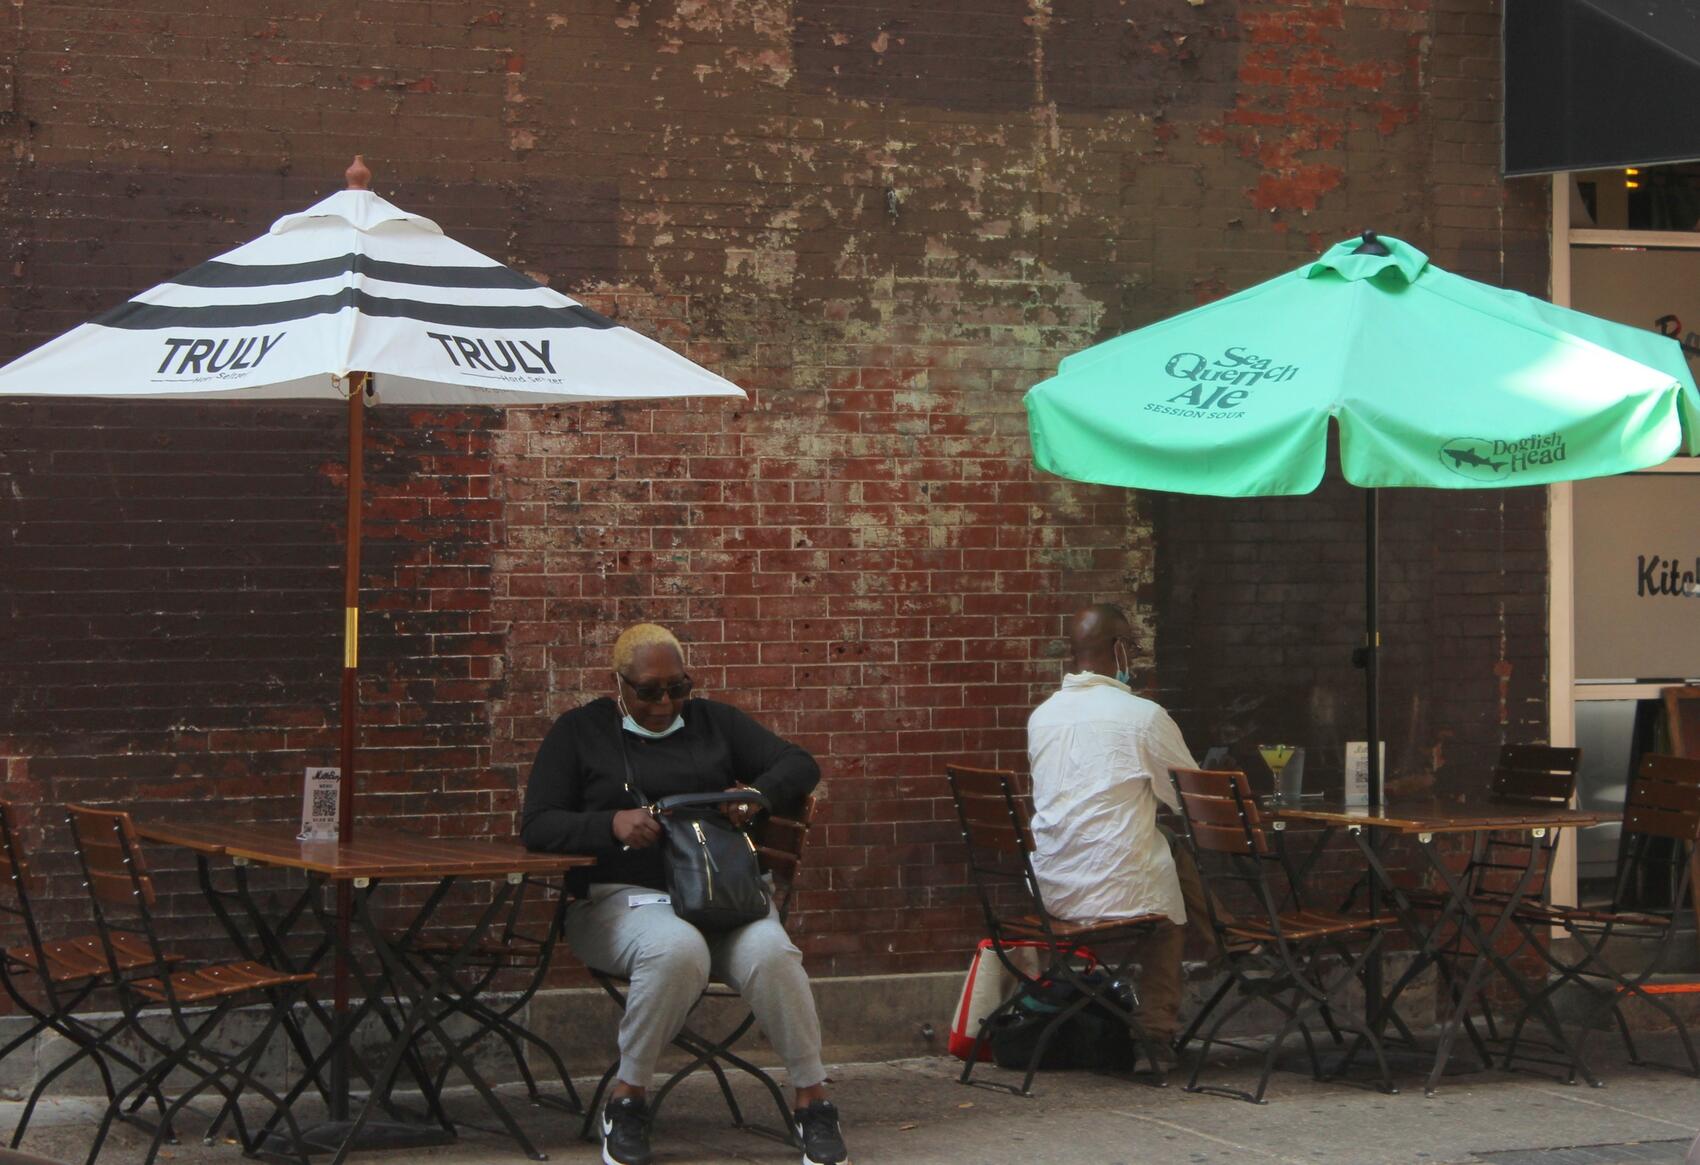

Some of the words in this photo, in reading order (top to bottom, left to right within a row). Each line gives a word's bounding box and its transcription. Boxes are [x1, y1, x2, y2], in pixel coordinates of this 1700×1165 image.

[157, 331, 287, 374] TRULY
[426, 331, 557, 374] TRULY
[1213, 346, 1273, 370] Sea
[1166, 382, 1249, 410] Ale
[1143, 402, 1206, 420] SESSION
[1207, 410, 1246, 420] SOUR
[1493, 431, 1562, 456] Dogfish
[1511, 442, 1566, 473] Head
